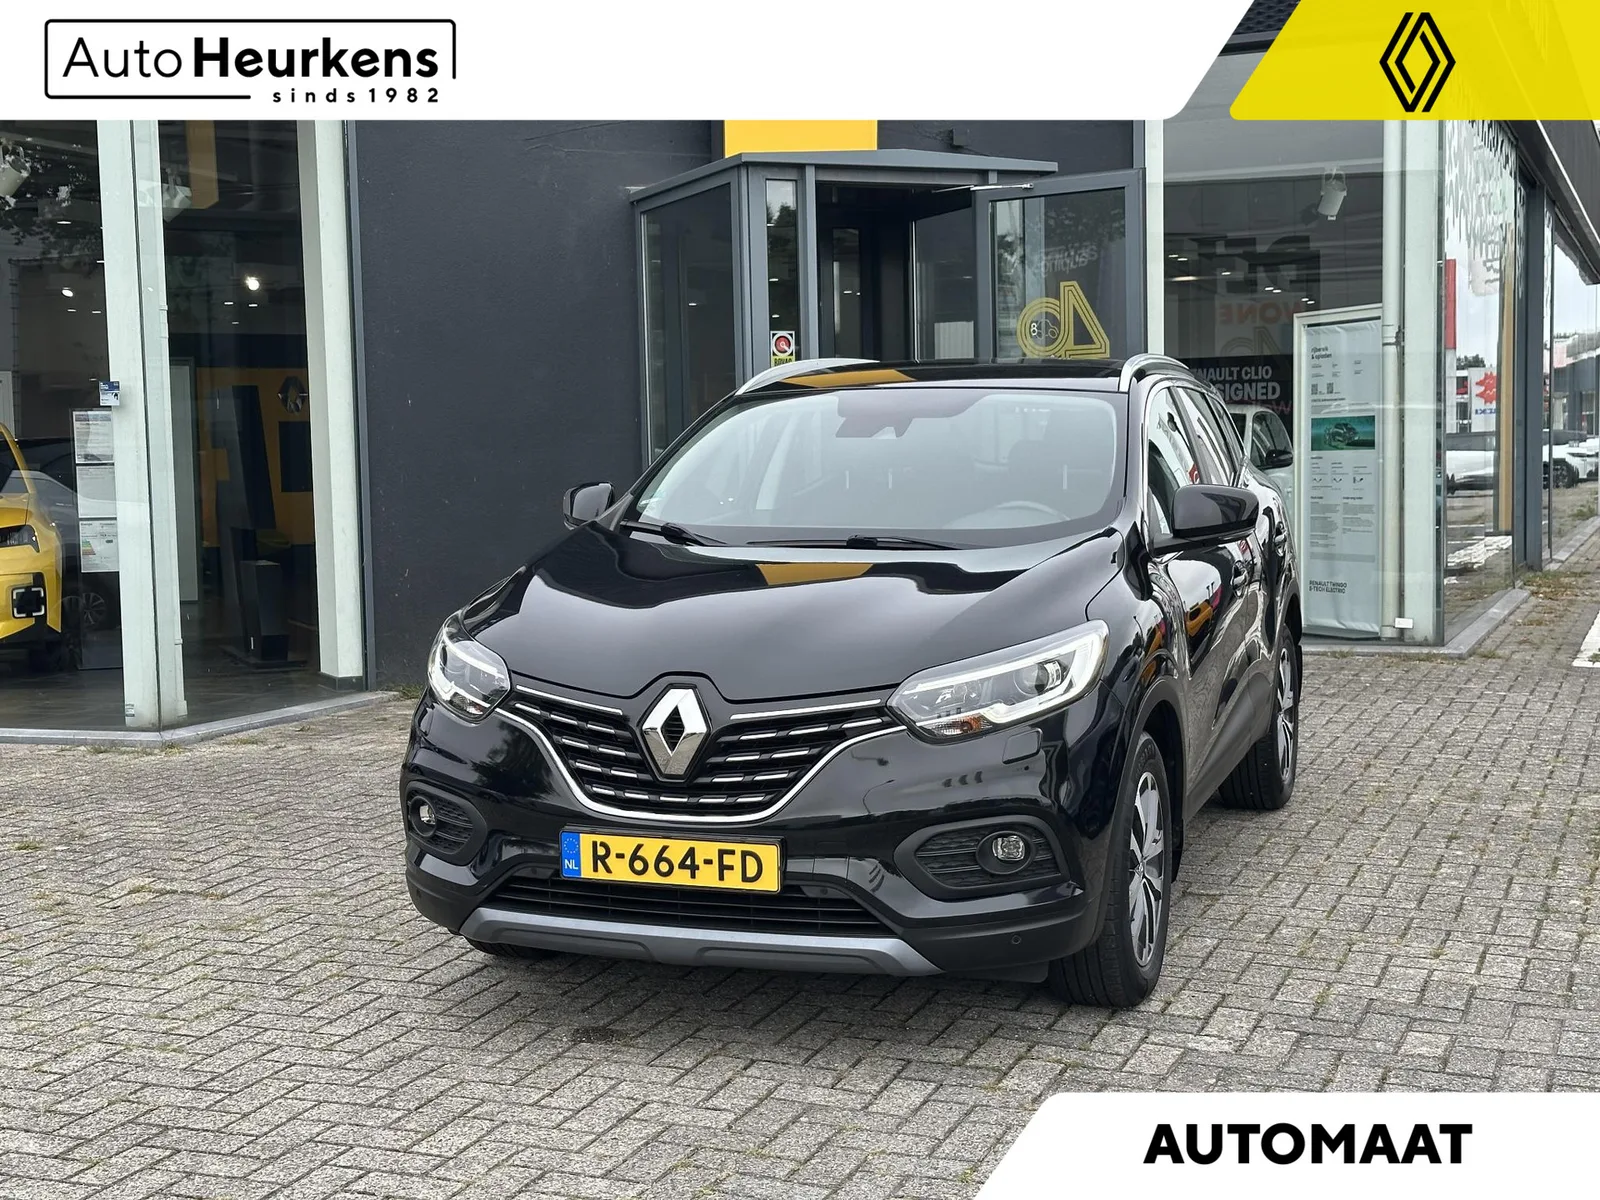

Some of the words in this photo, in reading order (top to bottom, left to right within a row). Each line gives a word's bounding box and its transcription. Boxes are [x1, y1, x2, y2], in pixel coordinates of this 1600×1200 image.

[1241, 365, 1273, 380] CLIO
[1215, 381, 1281, 401] SIGNED
[564, 859, 579, 870] NL
[591, 840, 764, 883] R-664-FD
